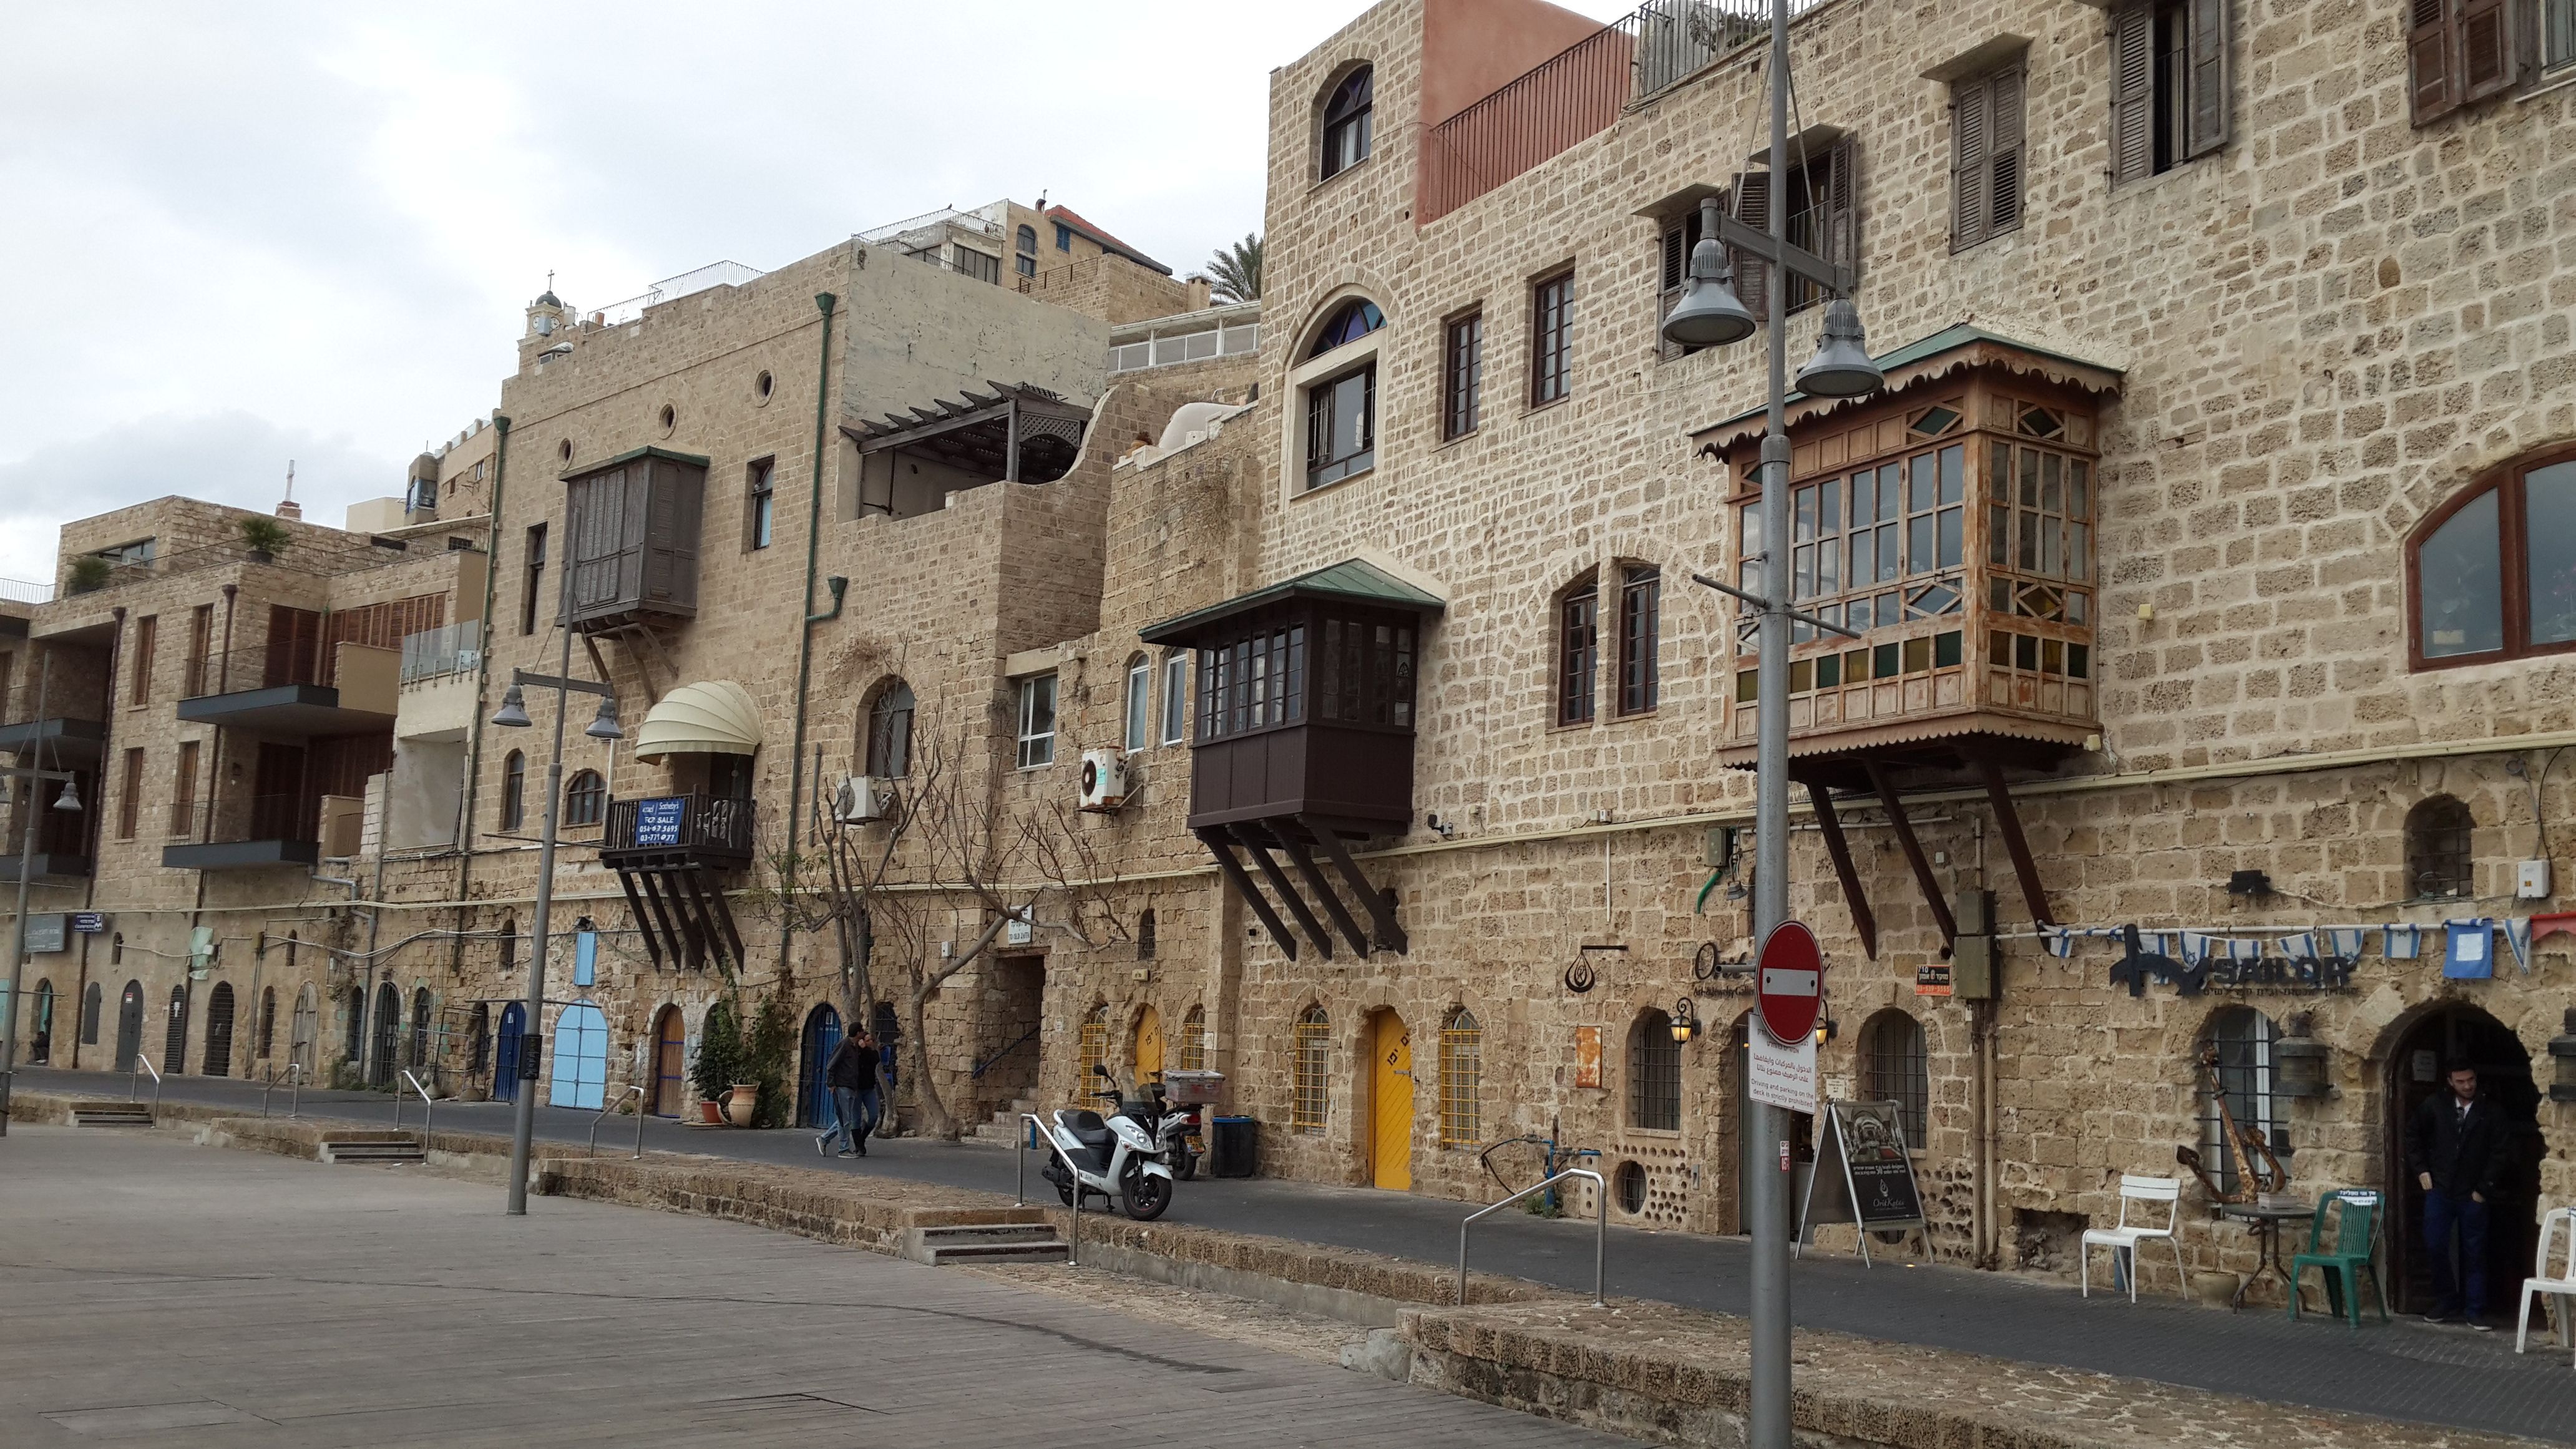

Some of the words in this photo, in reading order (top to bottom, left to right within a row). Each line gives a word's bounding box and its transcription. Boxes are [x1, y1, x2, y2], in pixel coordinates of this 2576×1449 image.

[2214, 957, 2350, 985] SAILOR
[1751, 1078, 1769, 1089] Driving
[1780, 1086, 1797, 1096] parking
[1753, 1088, 1764, 1096] deck
[1771, 1093, 1787, 1103] strictly
[1788, 1098, 1812, 1108] prohibited
